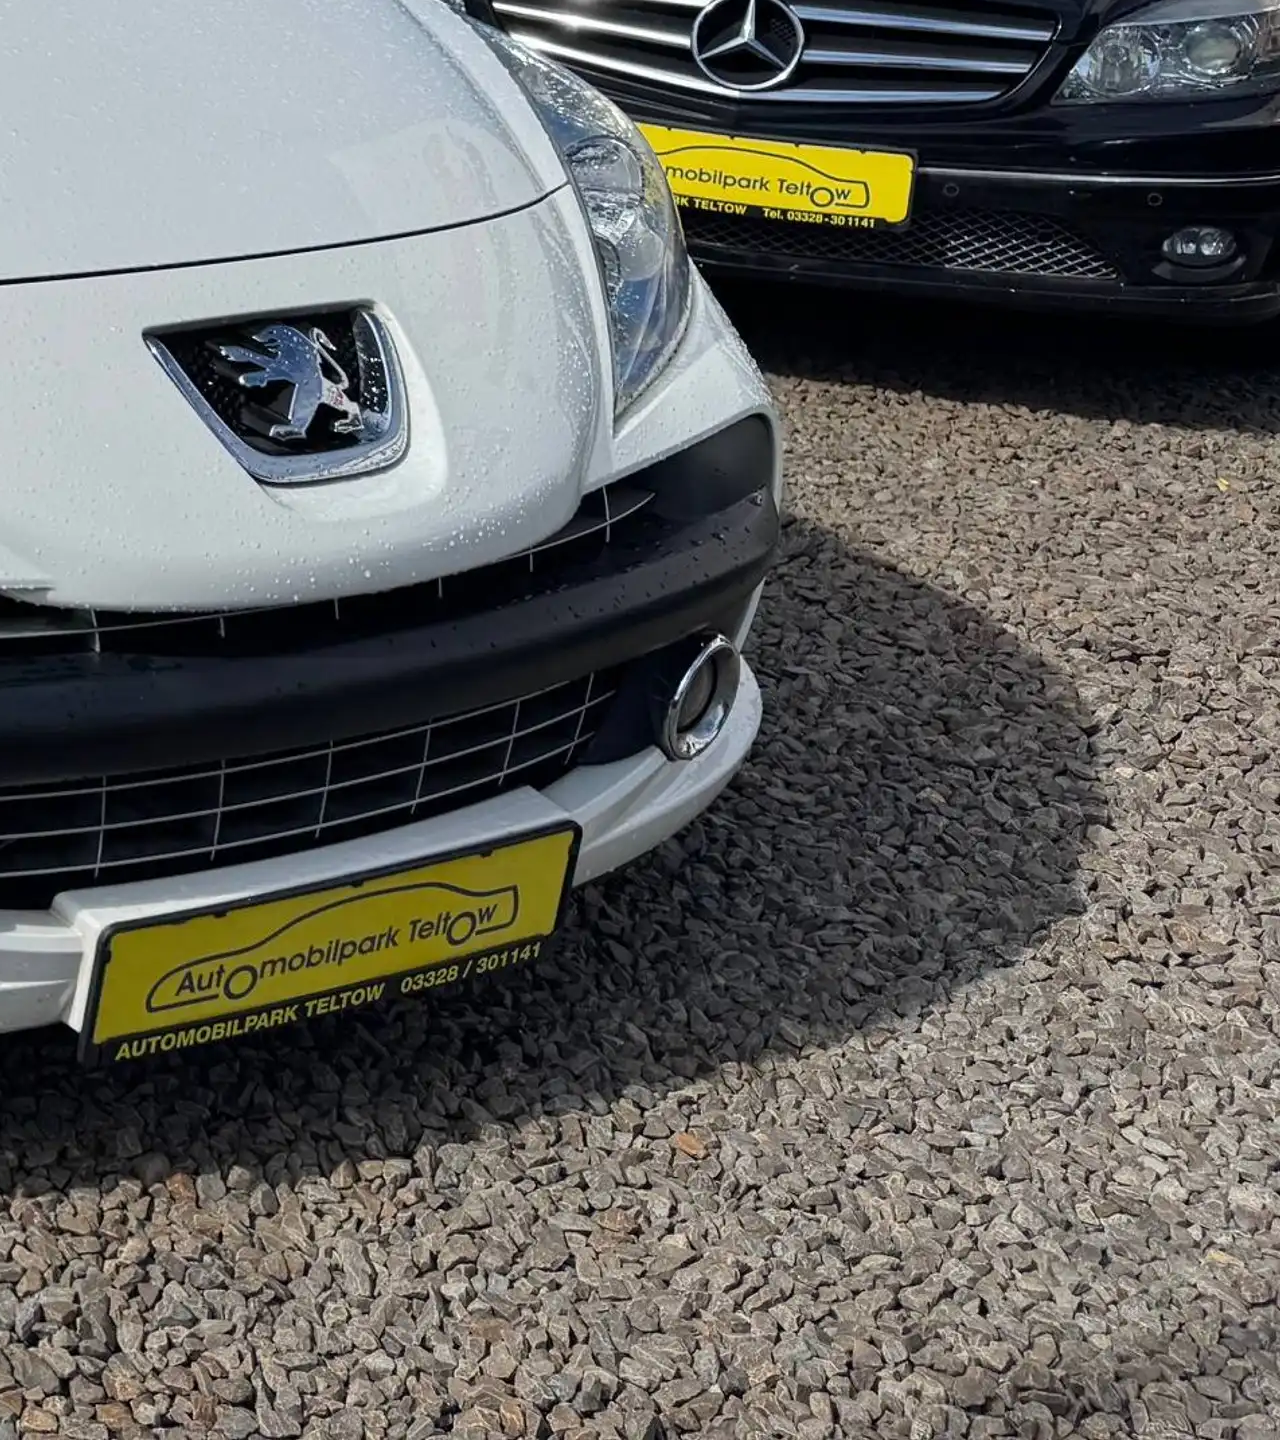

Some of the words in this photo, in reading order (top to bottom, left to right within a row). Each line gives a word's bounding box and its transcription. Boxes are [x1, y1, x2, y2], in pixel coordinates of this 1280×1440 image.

[693, 198, 747, 215] TELTOW
[762, 208, 784, 220] Tel.
[115, 1004, 300, 1060] AUTOMOBILPARK
[304, 982, 386, 1018] TELTOW
[400, 965, 459, 994] 03328
[476, 942, 541, 974] 301141
